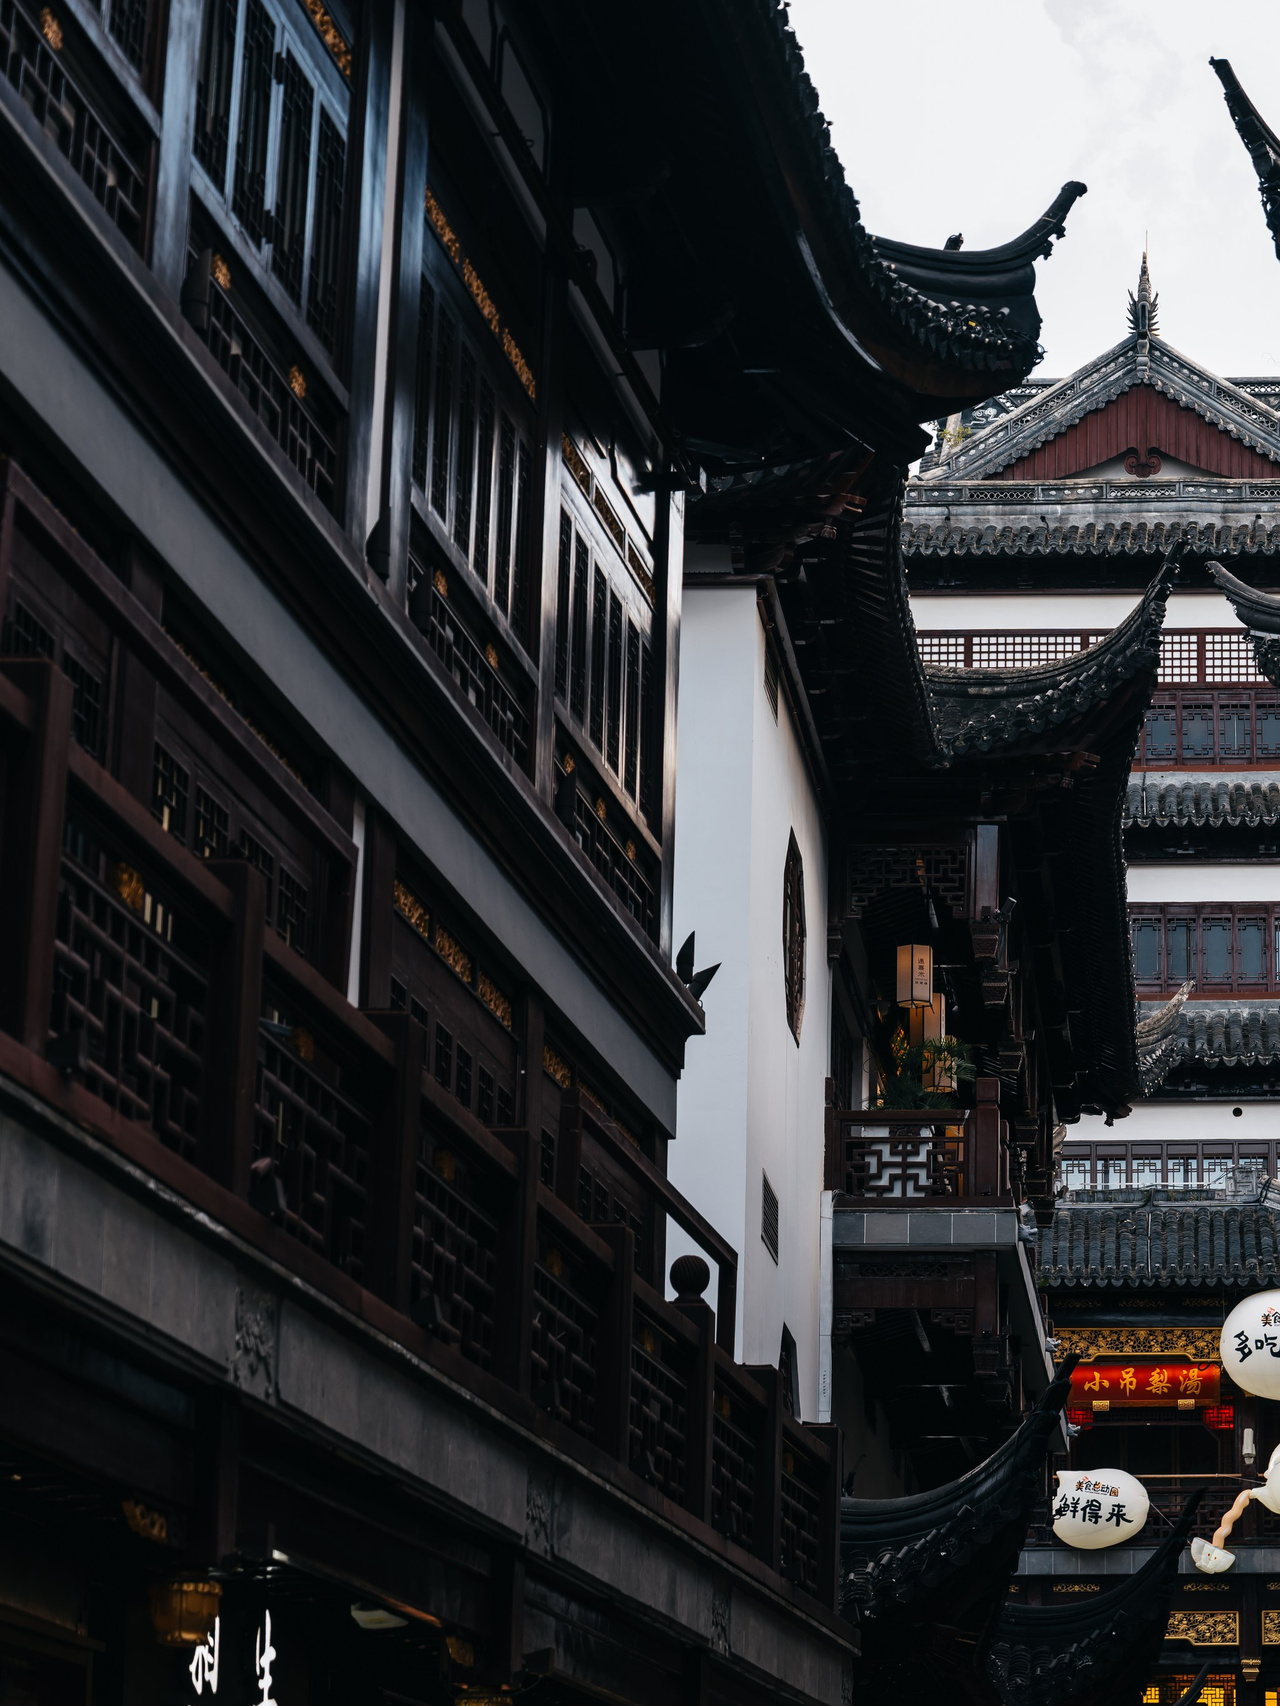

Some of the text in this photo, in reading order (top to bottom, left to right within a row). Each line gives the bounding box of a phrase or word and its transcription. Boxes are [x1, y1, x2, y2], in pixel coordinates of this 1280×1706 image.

[1083, 1367, 1204, 1397] 小吊梨湯
[1053, 1493, 1134, 1527] 鲜得来
